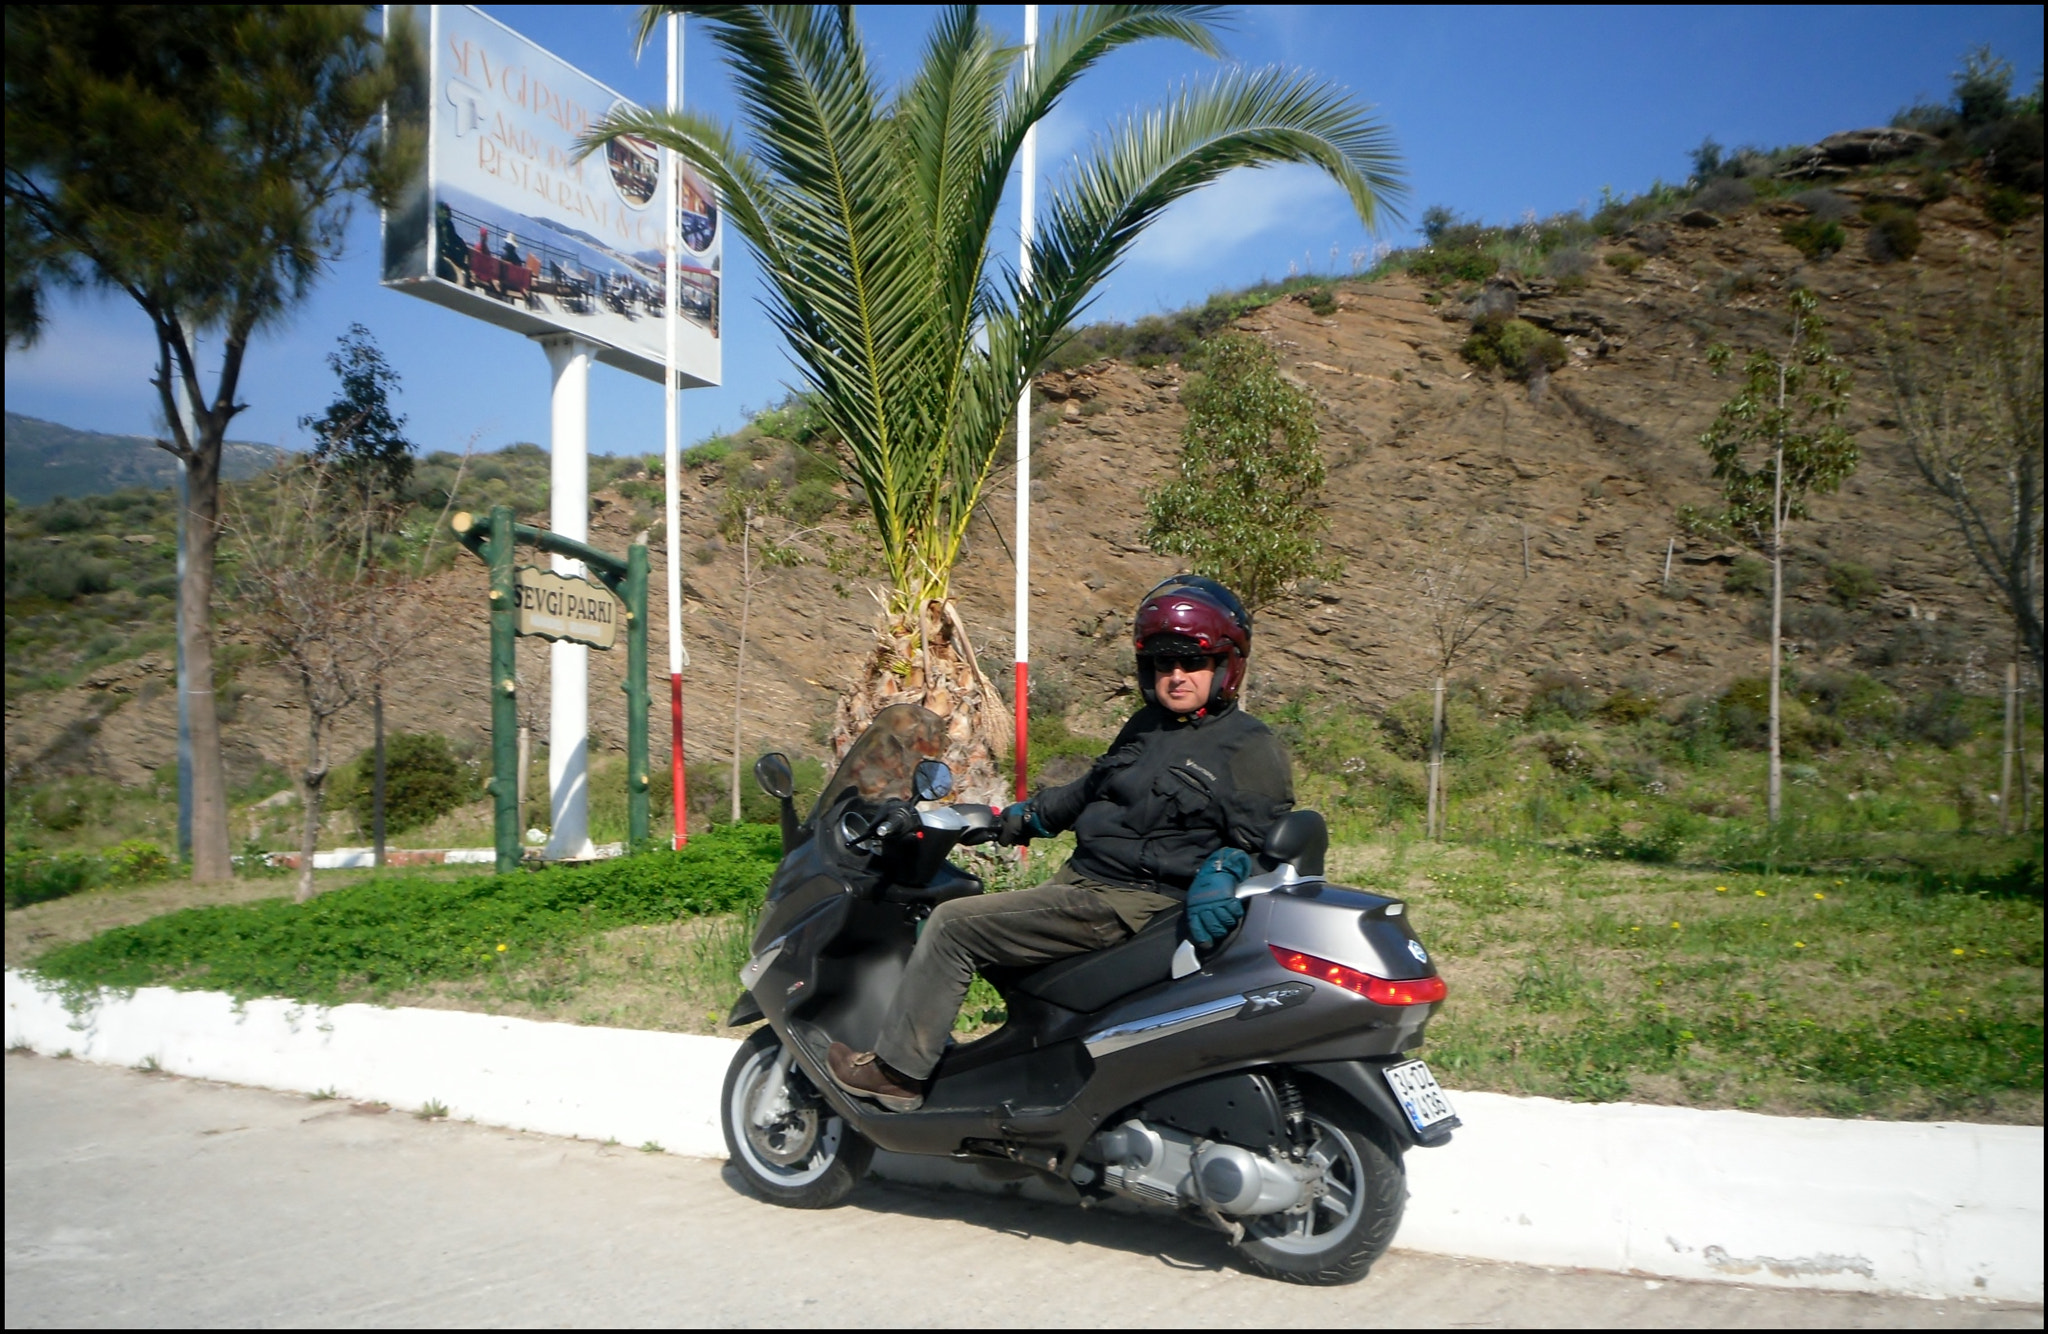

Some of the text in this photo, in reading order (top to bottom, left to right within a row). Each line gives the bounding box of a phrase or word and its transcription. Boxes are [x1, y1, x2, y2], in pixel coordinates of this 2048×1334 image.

[479, 135, 608, 227] RESTAURANT
[514, 584, 612, 624] SEVGİ PARKI
